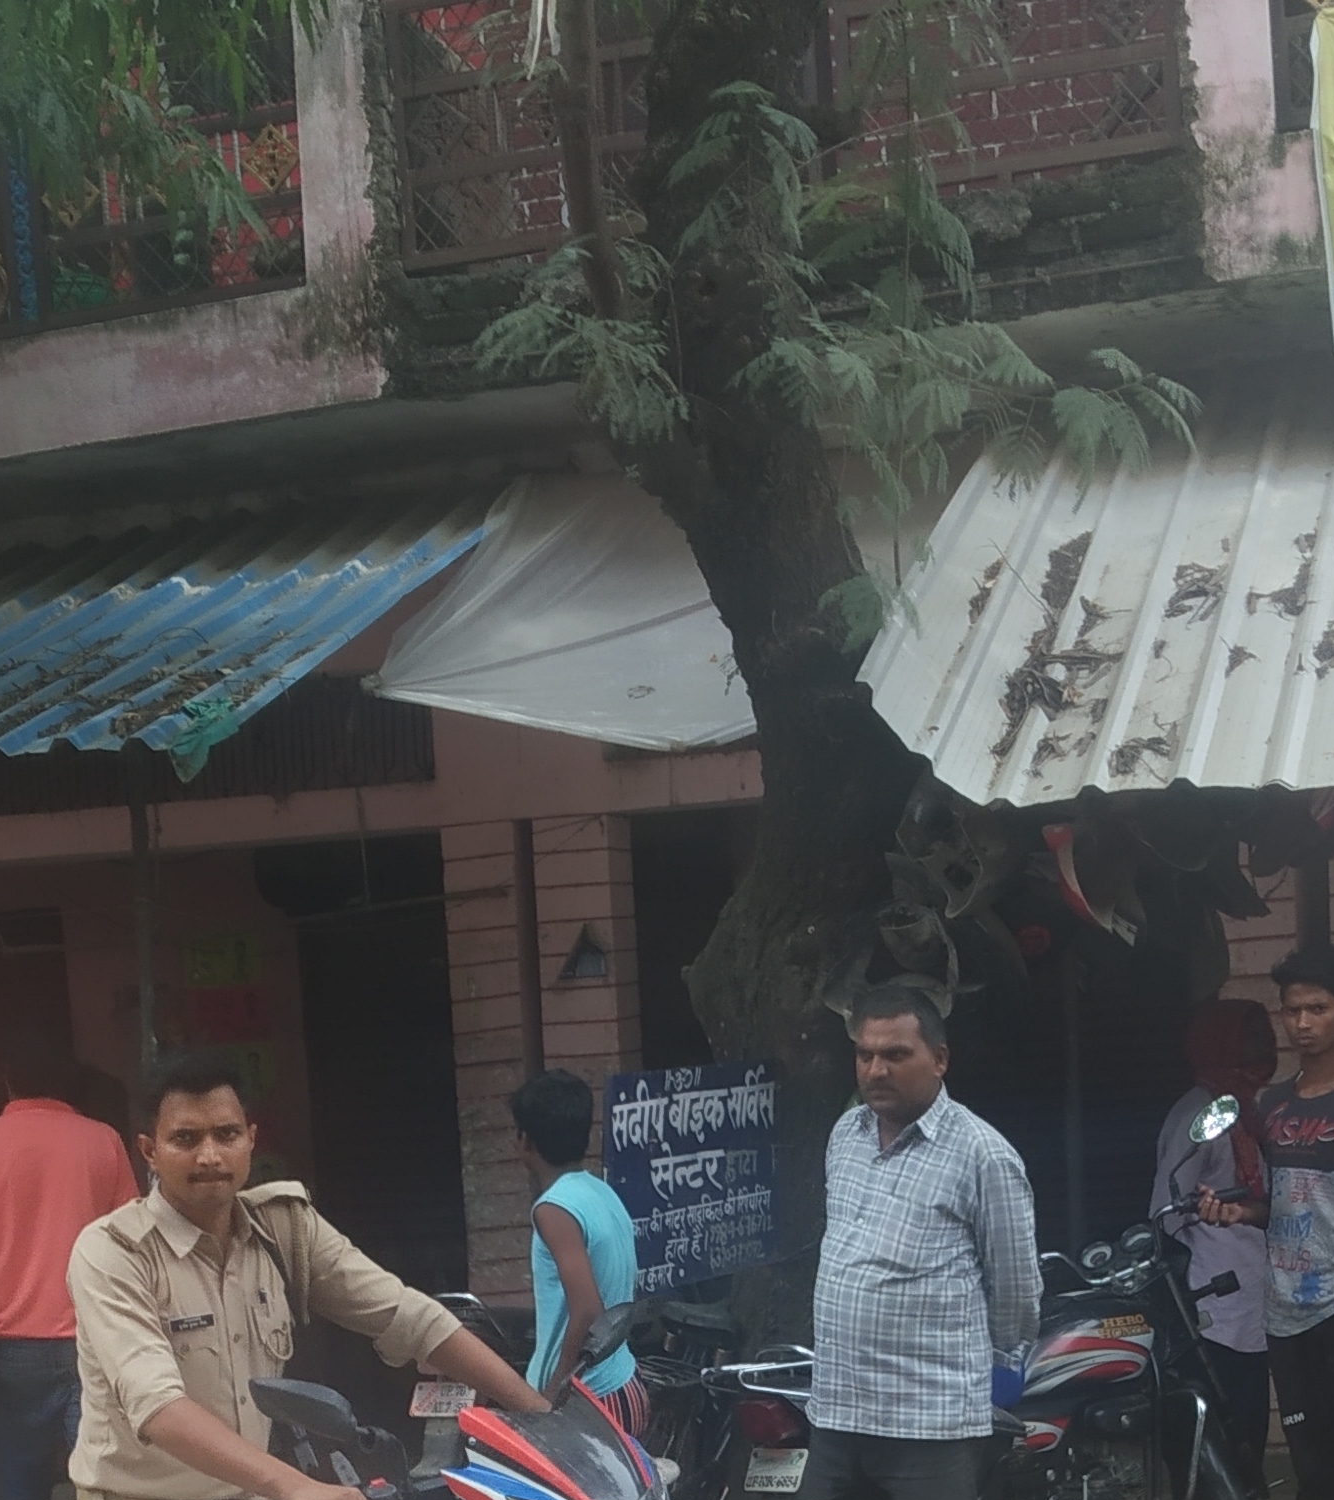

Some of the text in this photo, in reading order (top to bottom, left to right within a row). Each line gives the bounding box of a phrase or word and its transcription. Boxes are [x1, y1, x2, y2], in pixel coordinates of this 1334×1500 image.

[611, 1064, 776, 1153] संदीप बाइक सर्विस
[649, 1141, 726, 1202] सेन्टर
[650, 1206, 664, 1234] की
[1098, 1323, 1150, 1340] HONDA
[1101, 1313, 1145, 1329] HERO
